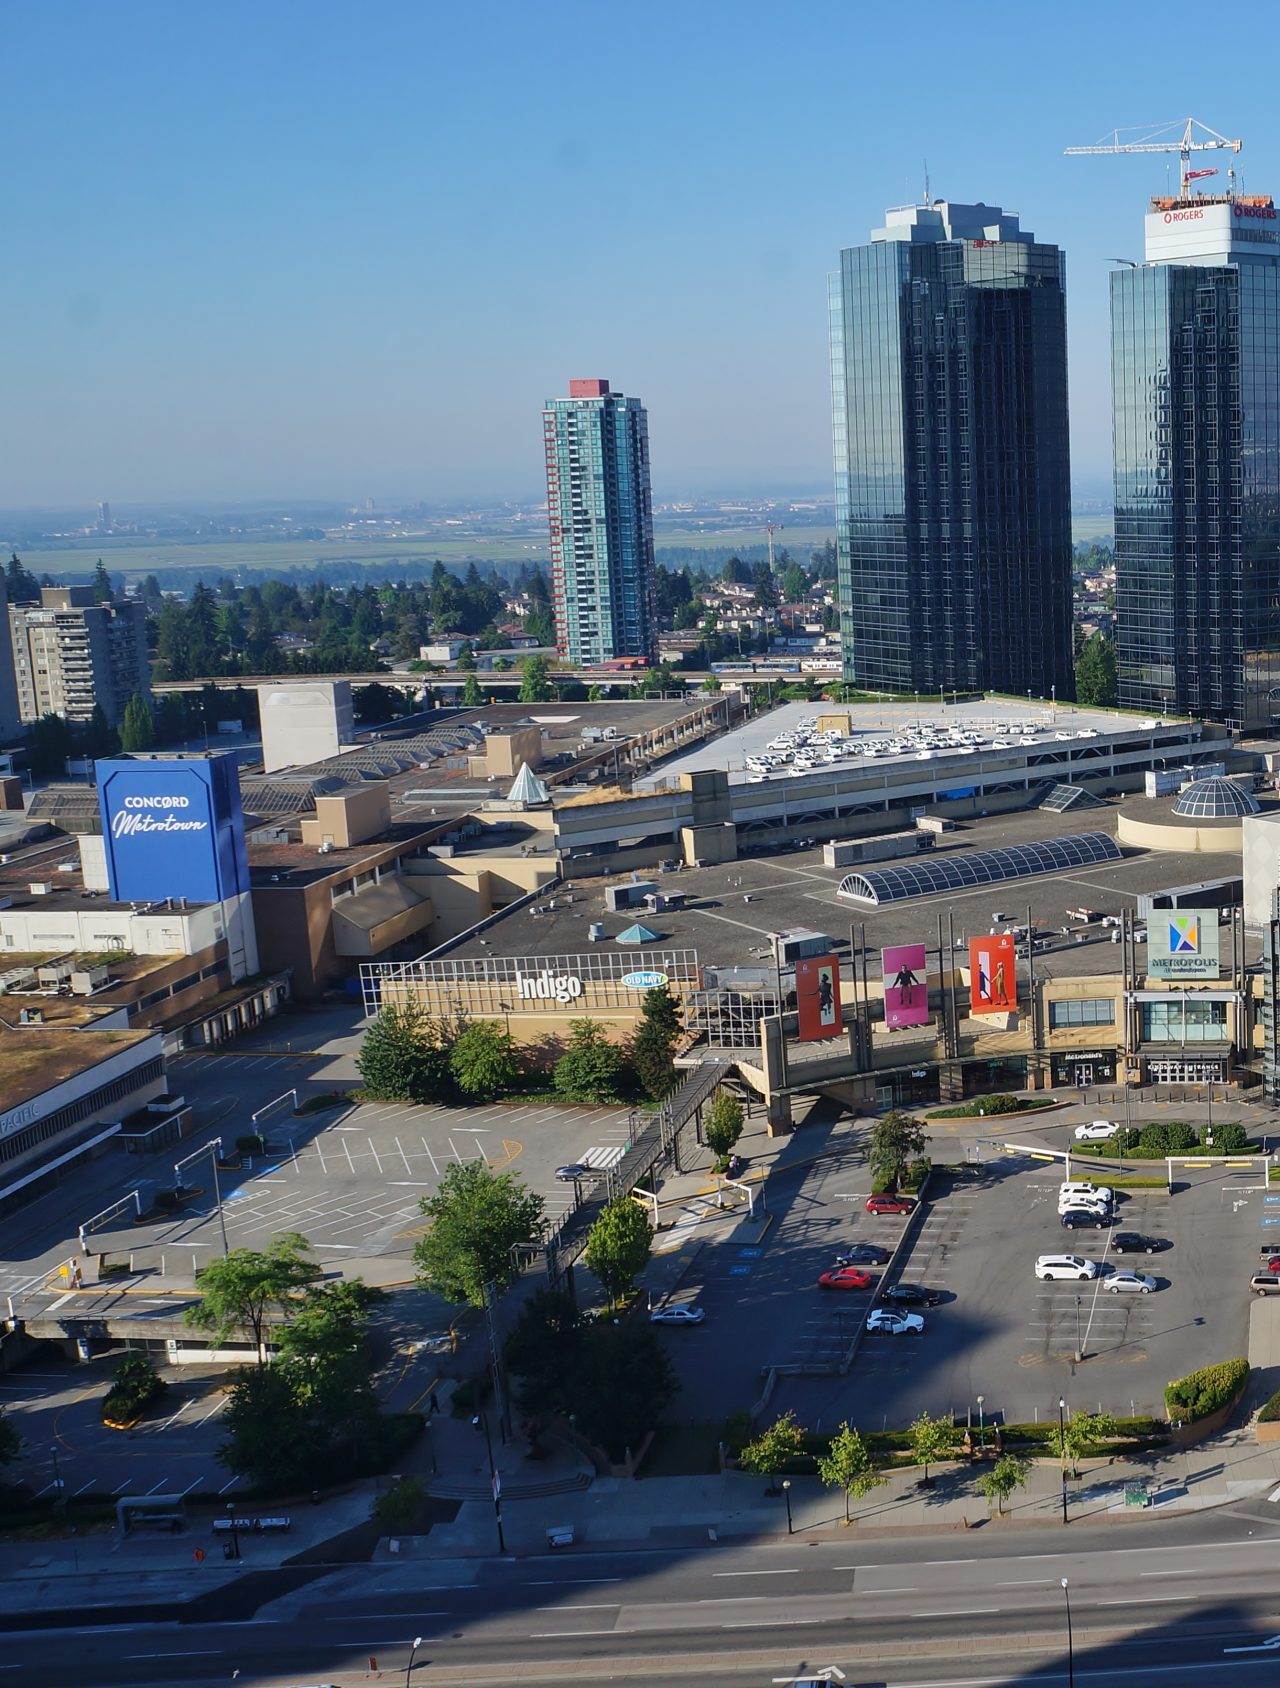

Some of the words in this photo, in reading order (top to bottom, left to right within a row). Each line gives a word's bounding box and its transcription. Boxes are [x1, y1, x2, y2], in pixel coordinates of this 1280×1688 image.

[1173, 209, 1204, 222] ROGERS
[1244, 208, 1277, 220] ROGERS
[112, 810, 207, 838] Metrotown
[1152, 958, 1218, 967] METROPOLIS
[626, 976, 641, 984] OLD
[642, 975, 662, 984] NAVY
[0, 1103, 39, 1134] PACIFIC
